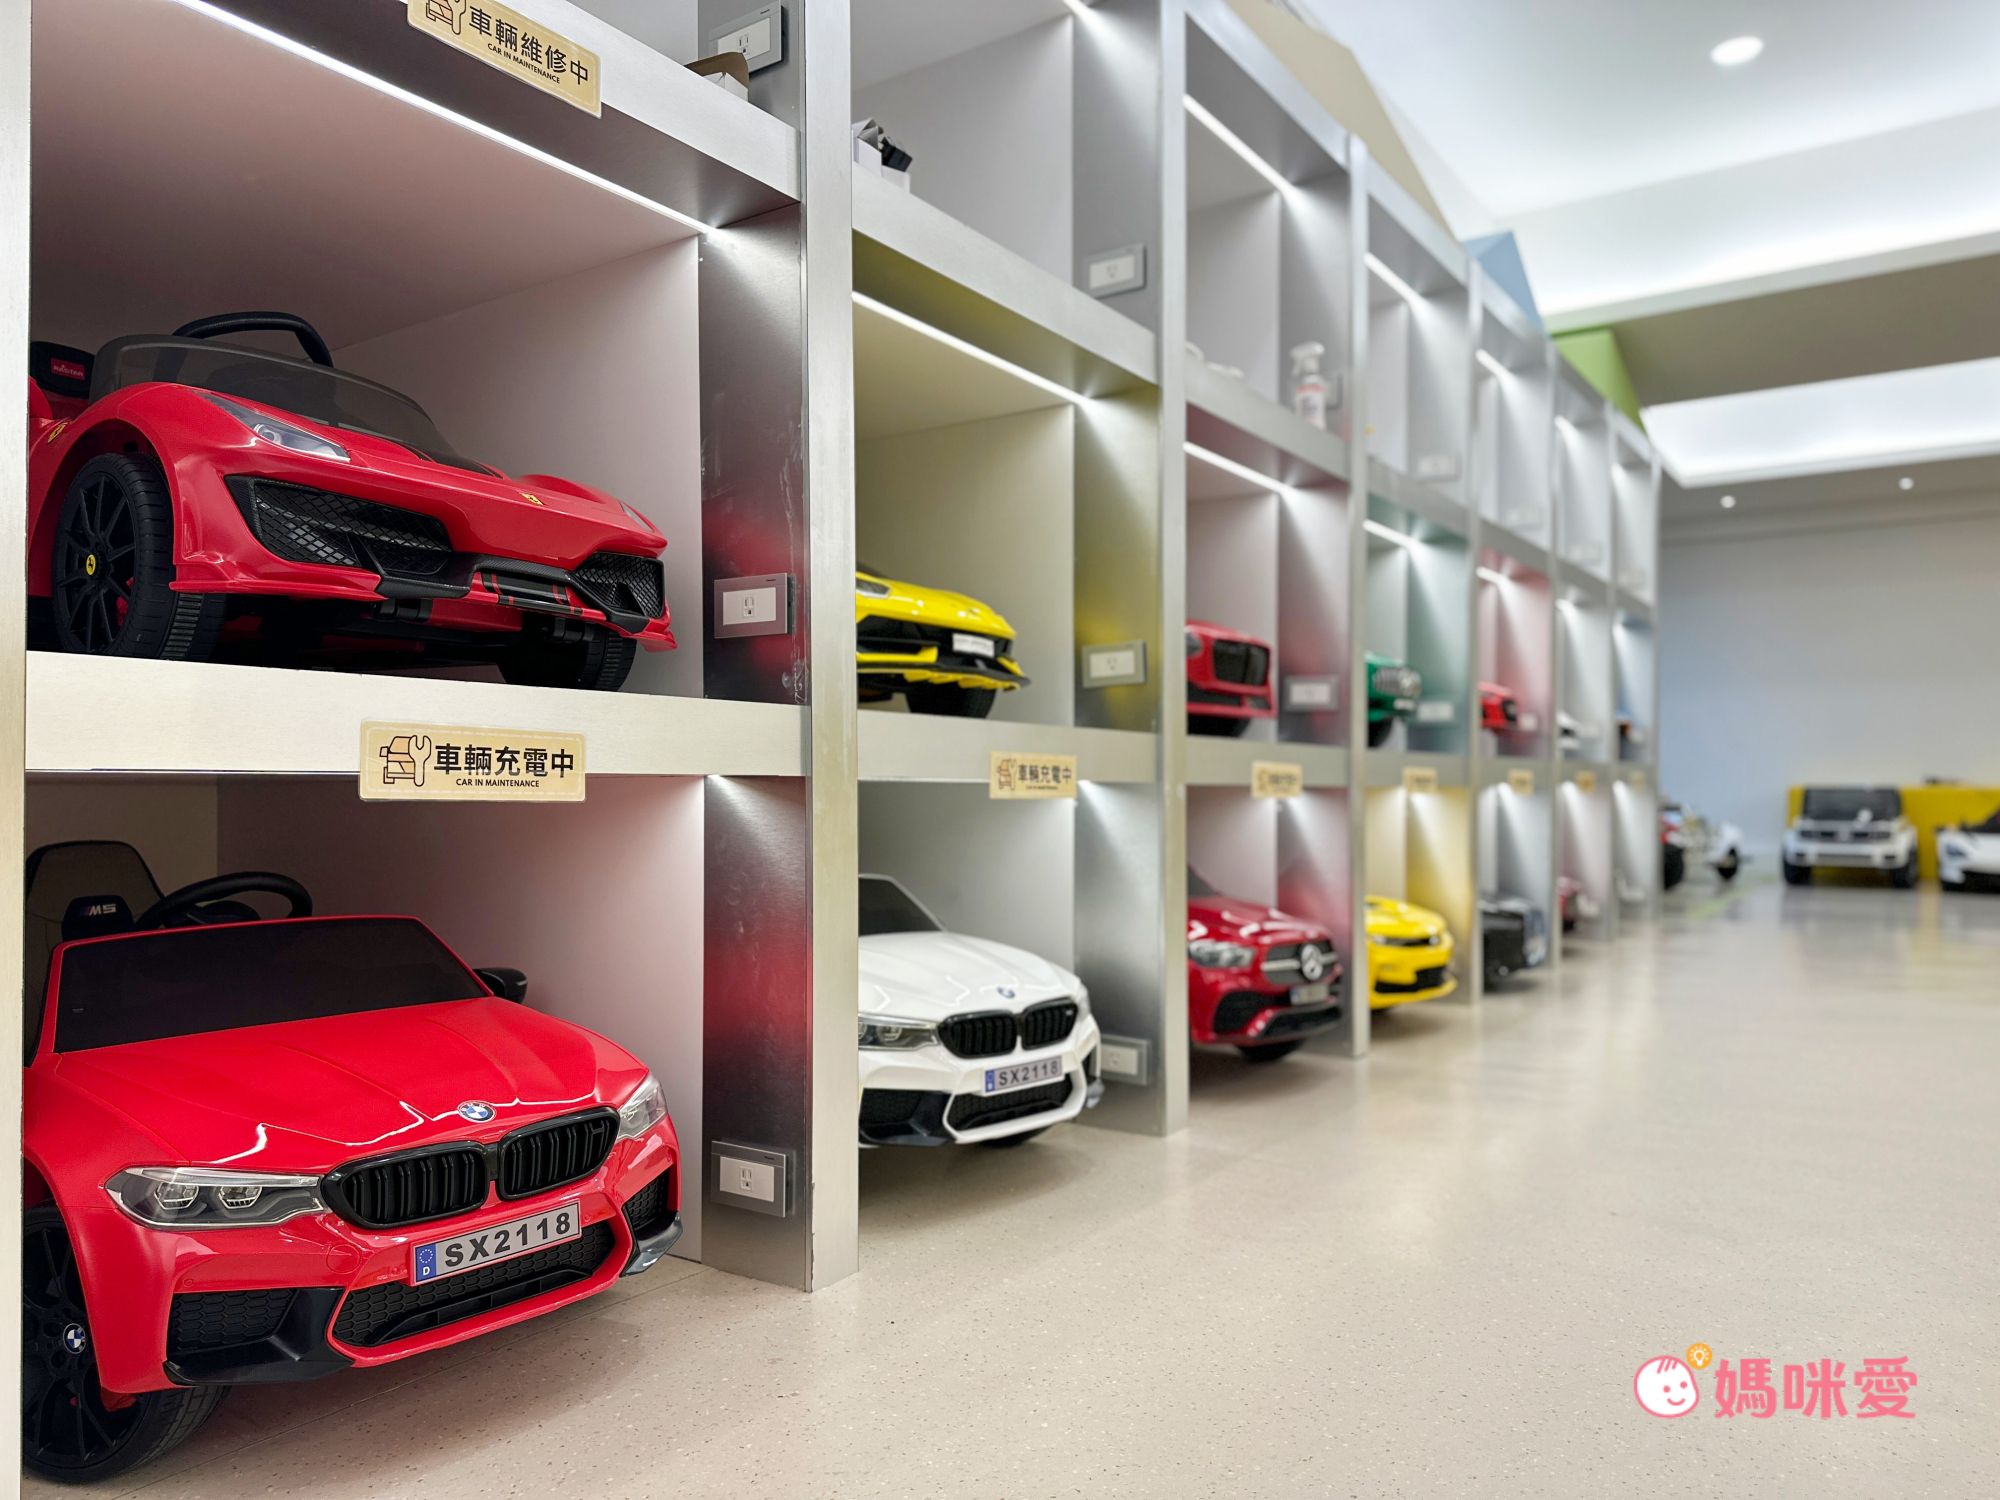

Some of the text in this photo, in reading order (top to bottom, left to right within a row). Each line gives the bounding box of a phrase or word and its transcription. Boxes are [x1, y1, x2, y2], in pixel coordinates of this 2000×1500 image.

[468, 7, 589, 86] 車輛維修中
[487, 43, 561, 84] CAR IN MAINTENANCE
[433, 743, 574, 779] 車輛充電中
[455, 778, 540, 788] CAR IN MAINTENANCE
[88, 903, 117, 917] M5
[998, 1060, 1058, 1086] SX2118
[422, 1211, 571, 1277] D SX2118
